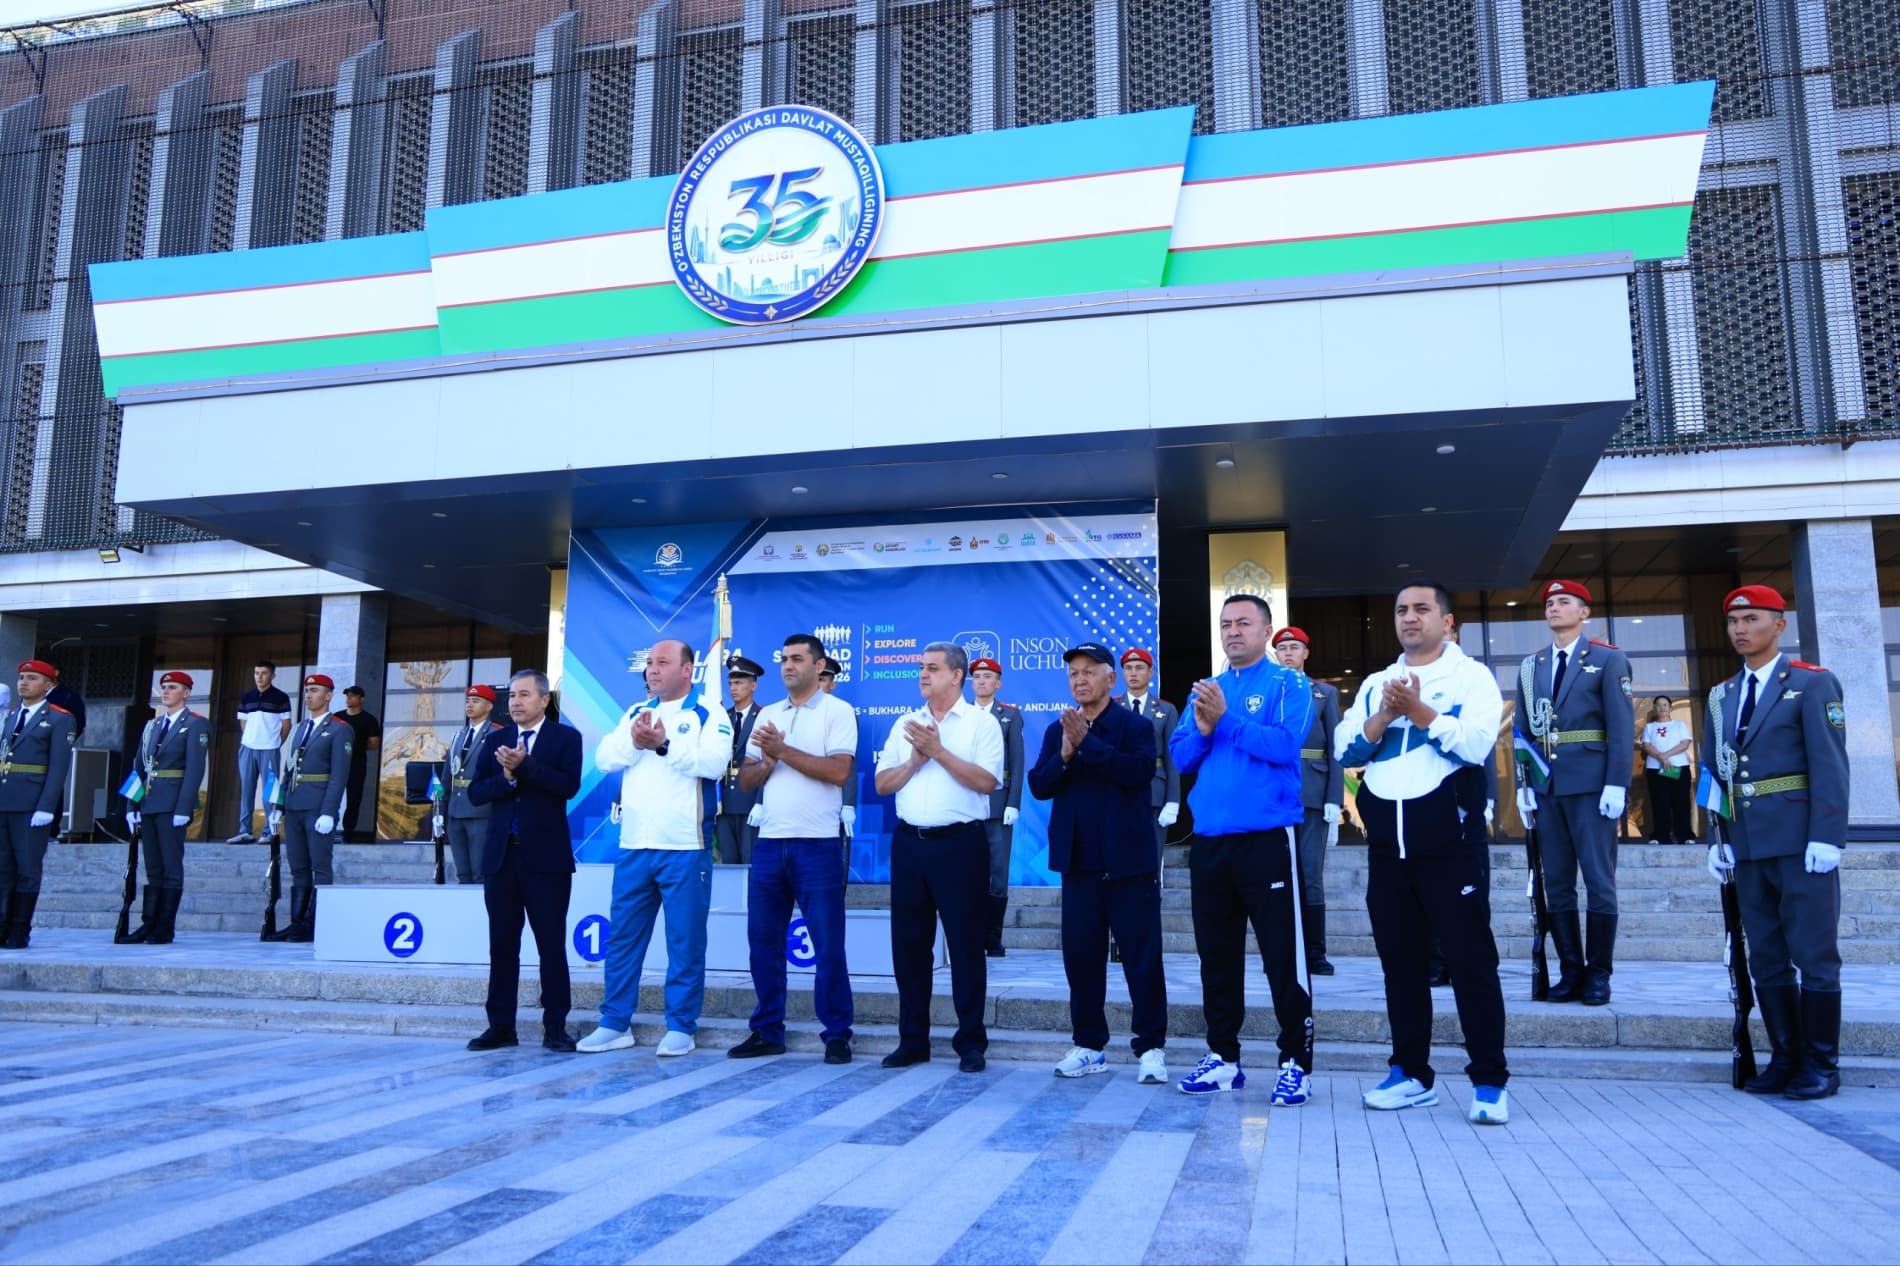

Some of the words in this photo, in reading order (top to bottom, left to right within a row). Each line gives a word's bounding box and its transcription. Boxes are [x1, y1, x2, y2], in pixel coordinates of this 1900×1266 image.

[690, 112, 777, 180] RESPUBLIKASI
[781, 112, 834, 135] DAVLAT
[833, 130, 876, 248] MUSTAQILLIGINING
[720, 166, 834, 253] 35
[875, 624, 894, 633] RUN
[874, 639, 917, 648] EXPLORE
[1010, 636, 1066, 652] INSON
[874, 654, 922, 664] DISCOVER
[1010, 653, 1061, 669] UCHU
[873, 670, 921, 680] INCLUSIO
[868, 706, 913, 716] BUKHARA
[1024, 702, 1068, 712] ANDIJAN
[392, 918, 415, 949] 2
[583, 922, 600, 954] 1
[792, 926, 816, 959] 3
